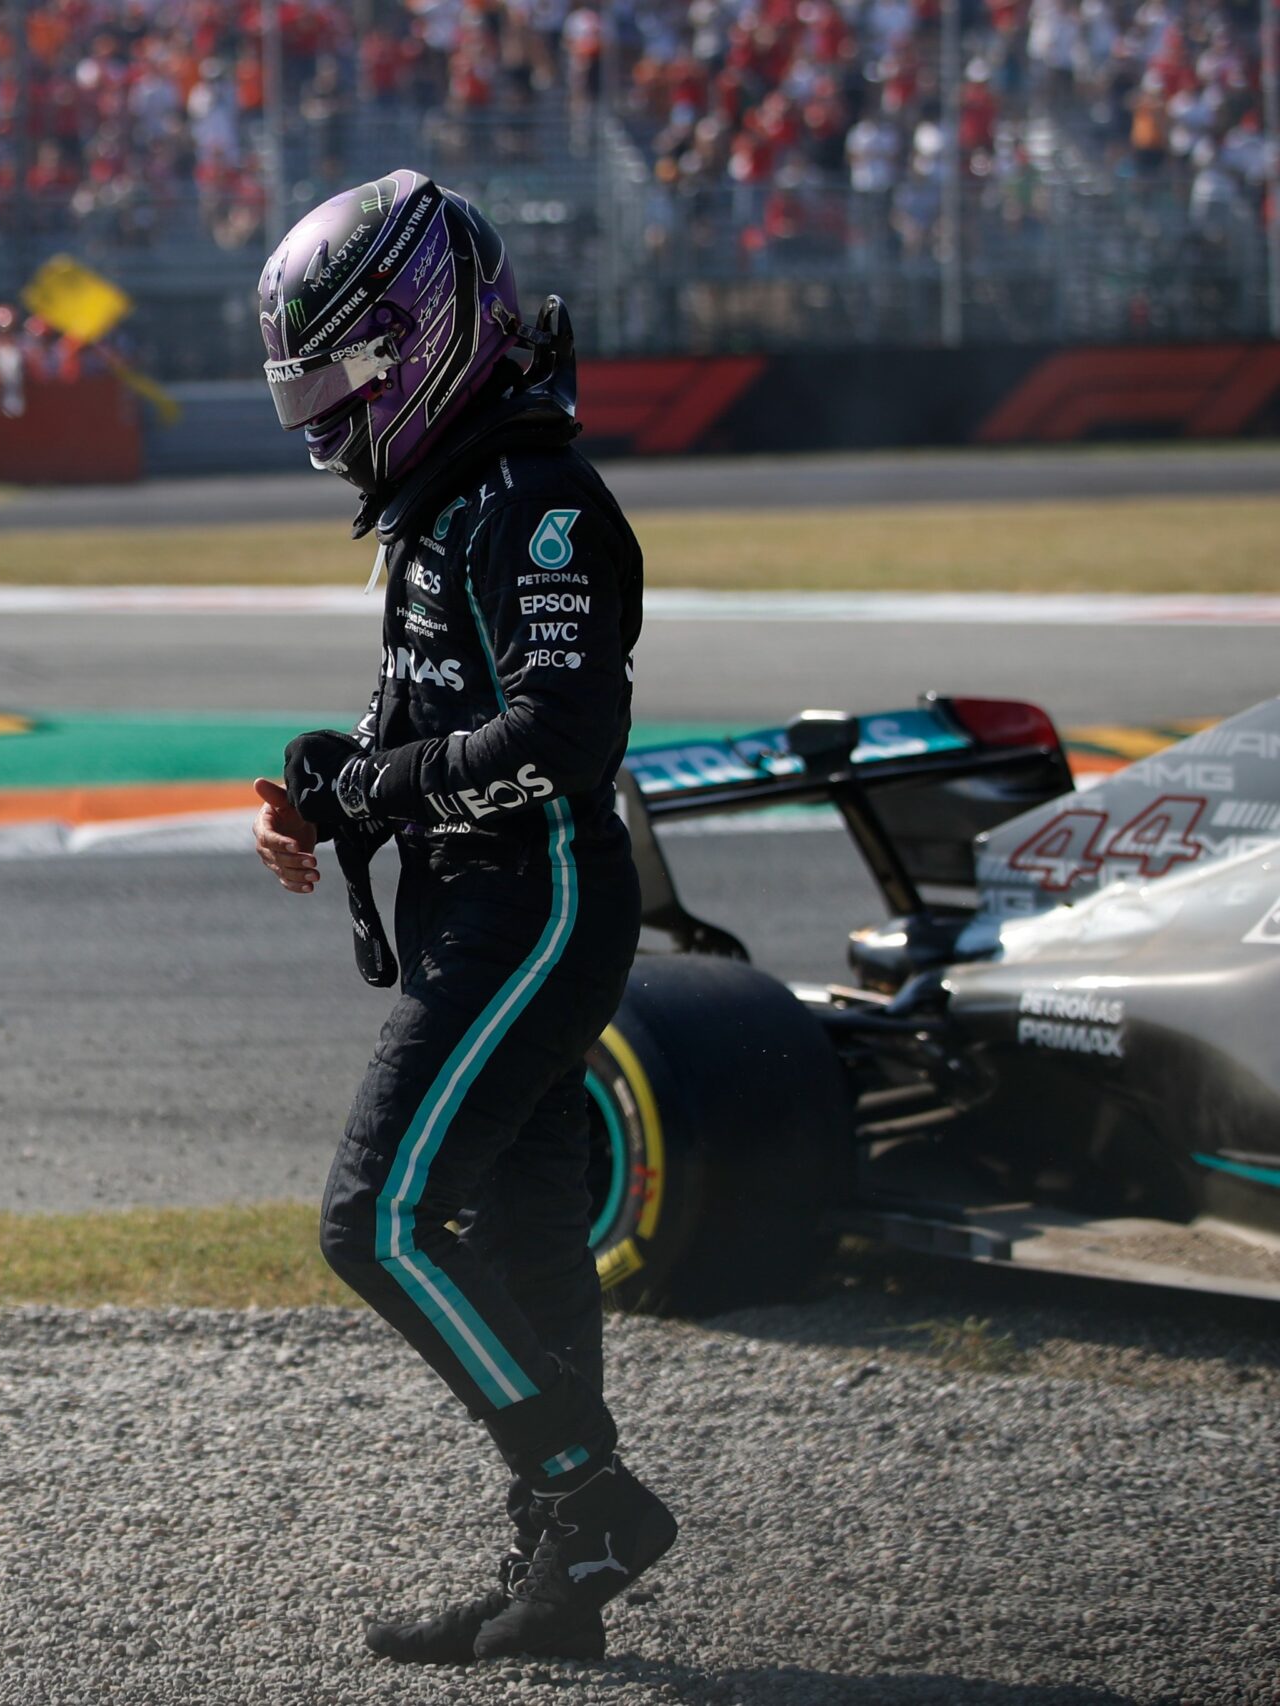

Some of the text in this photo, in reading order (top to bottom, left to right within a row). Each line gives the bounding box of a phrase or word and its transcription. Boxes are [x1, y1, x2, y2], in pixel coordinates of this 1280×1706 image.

[377, 194, 433, 273] CROWDSTRIKE
[298, 287, 369, 358] CROWDSTRIKE
[404, 560, 442, 595] INEOS
[517, 572, 589, 587] PETRONAS
[519, 593, 590, 615] EPSON
[417, 614, 448, 632] Packard
[528, 622, 578, 642] IWC
[425, 763, 554, 821] INEOS
[1008, 794, 1208, 892] 44
[1019, 989, 1124, 1025] PETRONAS
[1018, 1018, 1124, 1058] PRIMAX
